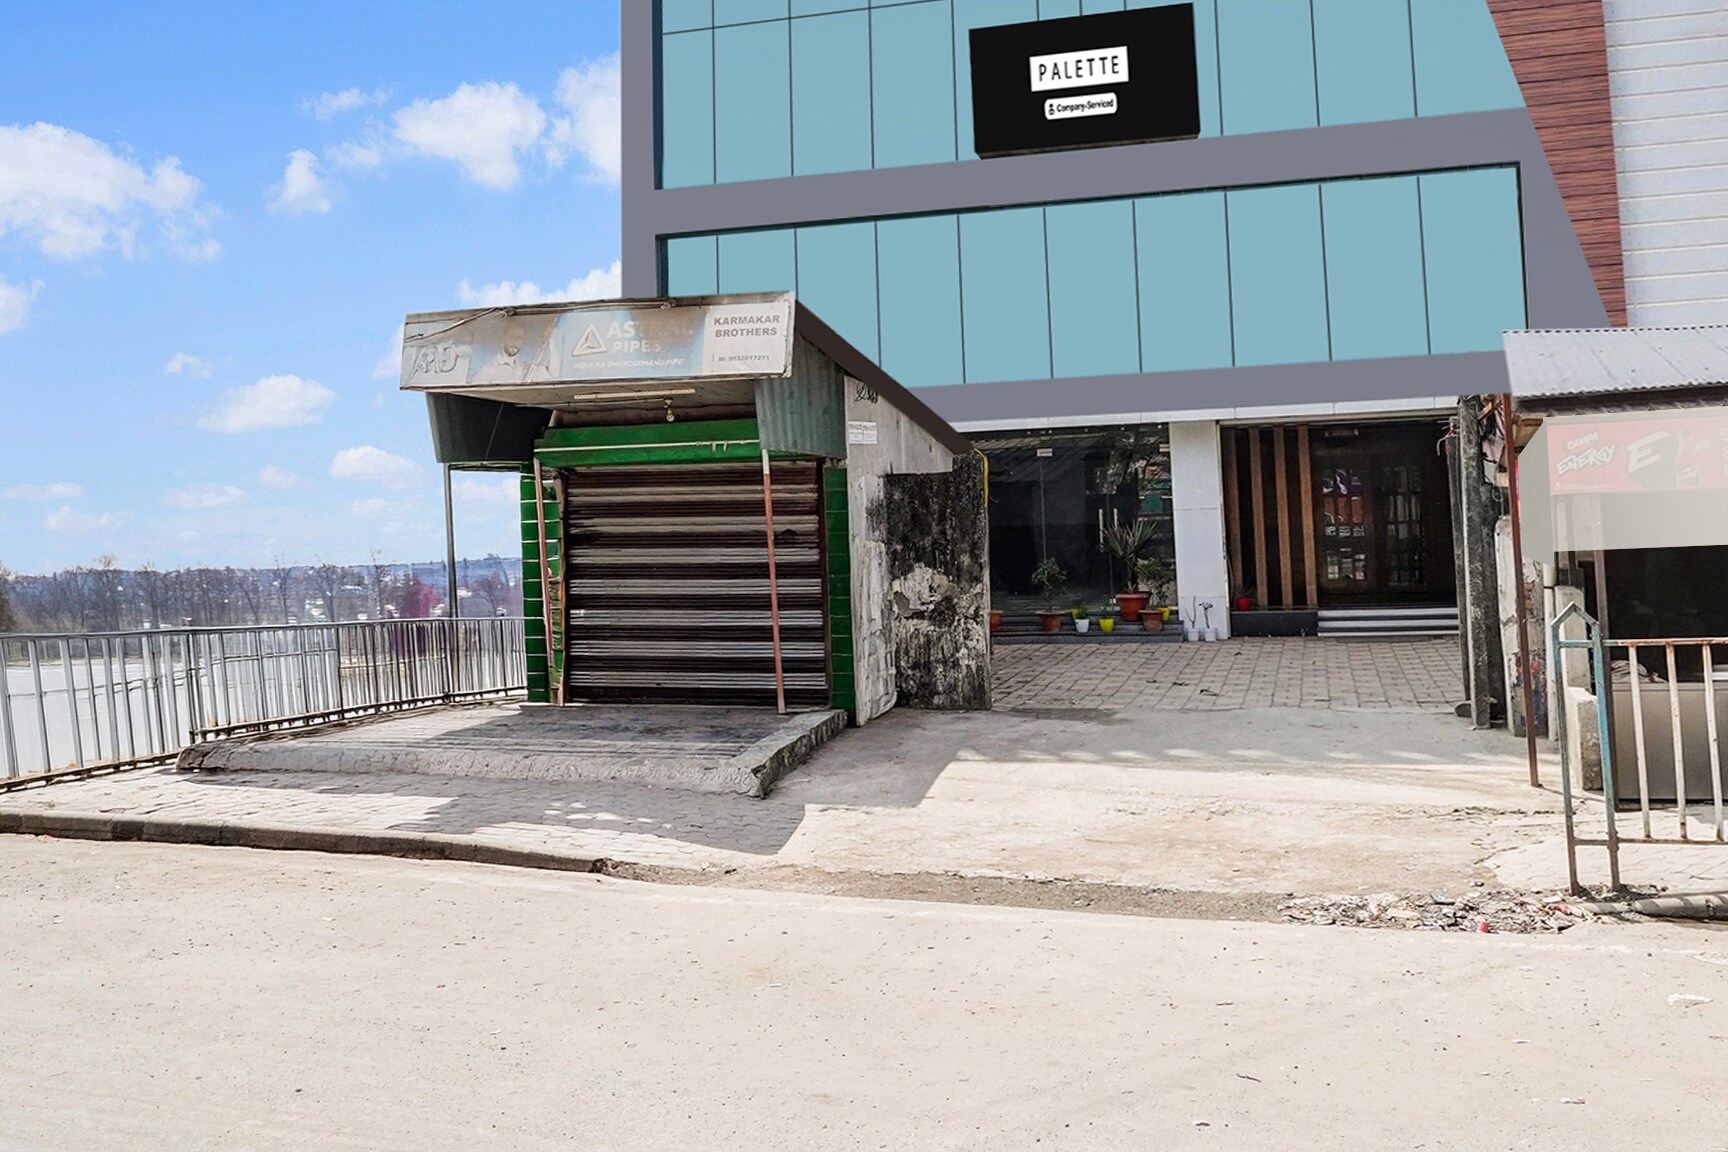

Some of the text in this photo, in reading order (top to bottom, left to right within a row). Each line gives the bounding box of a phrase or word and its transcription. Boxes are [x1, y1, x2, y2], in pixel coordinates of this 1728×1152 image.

[1038, 55, 1120, 82] PALETTE
[714, 315, 780, 326] KARMAKAR
[715, 327, 778, 338] BROTHERS
[1566, 431, 1600, 450] CAMPA
[1556, 444, 1616, 476] ENERGY
